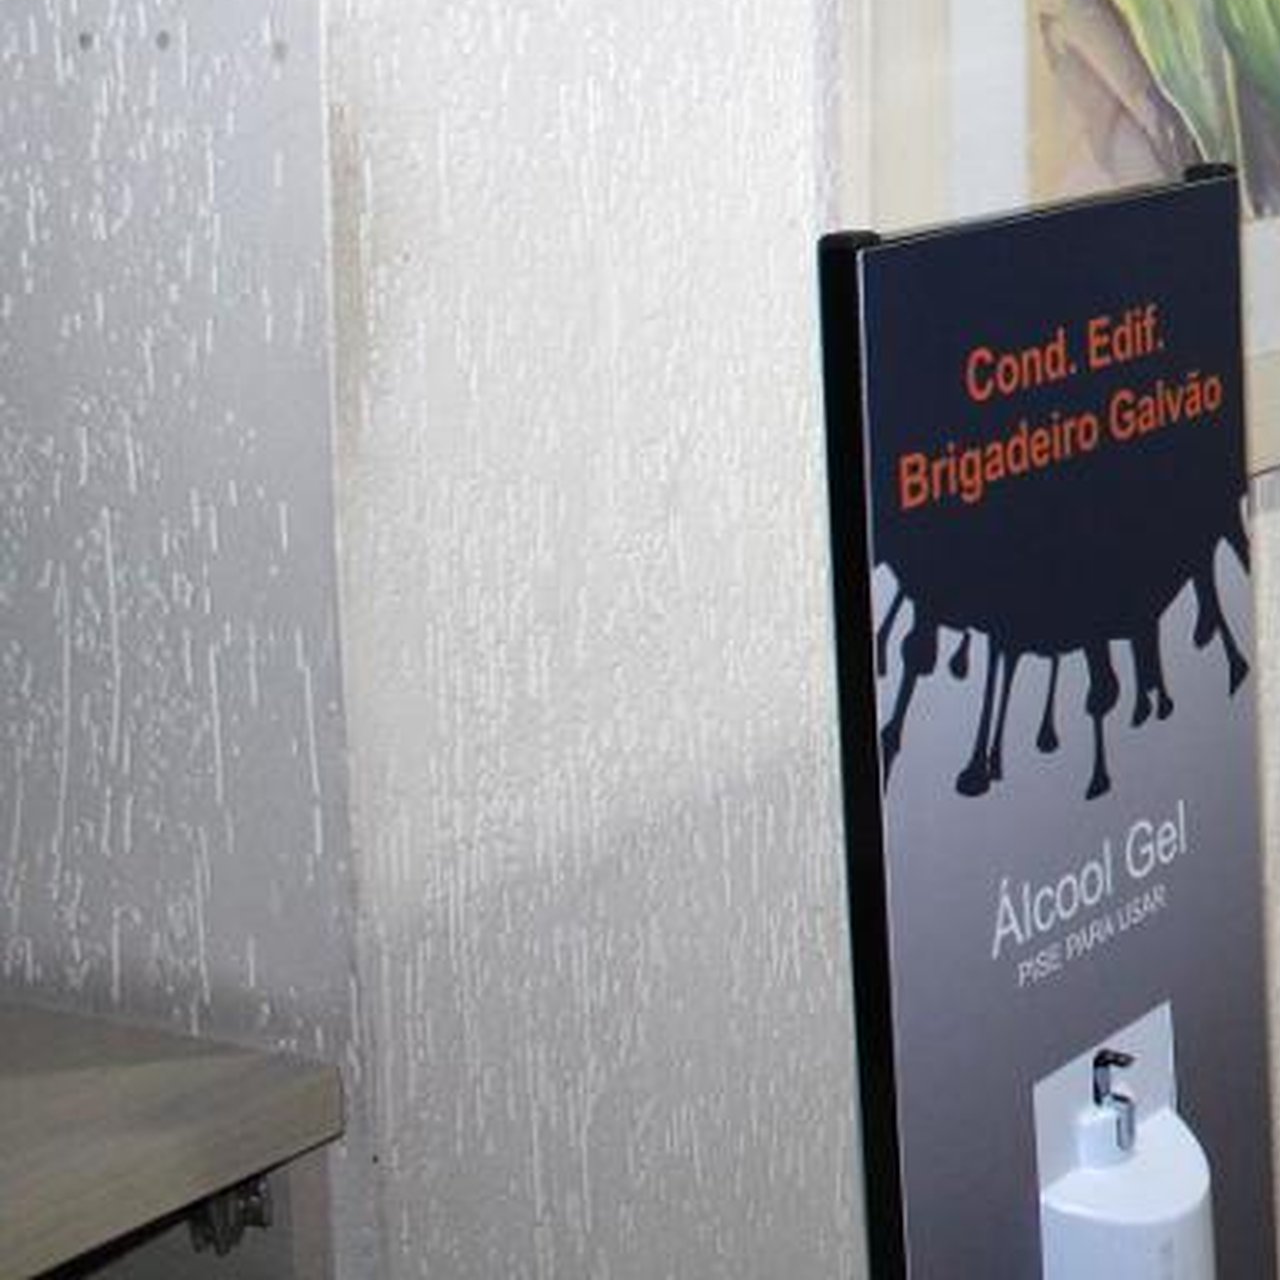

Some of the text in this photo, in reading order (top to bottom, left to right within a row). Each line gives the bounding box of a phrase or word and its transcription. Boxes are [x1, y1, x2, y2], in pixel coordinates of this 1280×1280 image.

[966, 304, 1166, 402] Cond. Edif.
[899, 370, 1224, 509] Brigadeiro Galvão
[992, 797, 1187, 961] Álcool Gel
[1017, 884, 1168, 988] PISE PARA USAR
